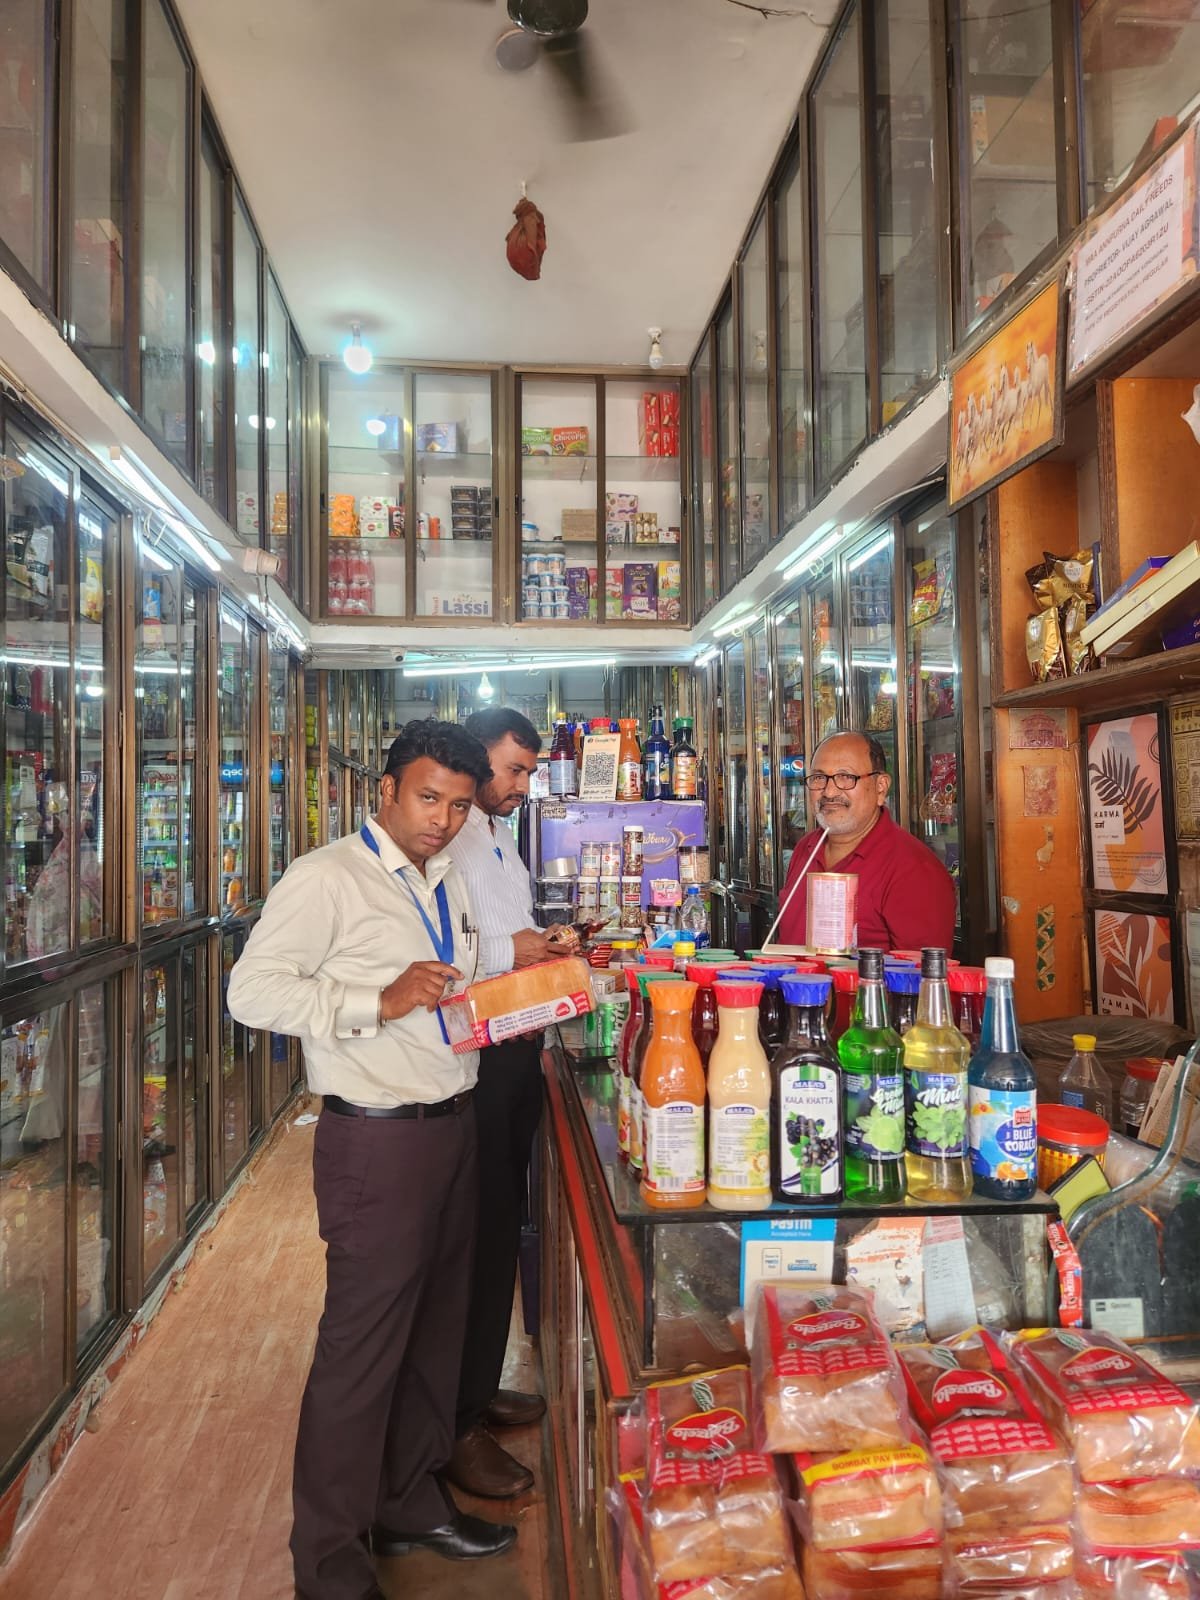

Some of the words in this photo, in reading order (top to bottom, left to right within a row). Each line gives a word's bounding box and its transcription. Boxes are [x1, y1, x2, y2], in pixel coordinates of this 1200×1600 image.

[1140, 198, 1174, 234] AGRAWAL
[443, 600, 489, 615] Lassi
[1094, 810, 1120, 818] KARMA
[1101, 997, 1130, 1012] YAMA
[785, 1095, 804, 1105] KALA
[806, 1096, 834, 1105] KHATTA
[917, 1084, 962, 1107] Mint
[1013, 1128, 1034, 1140] BLUE
[832, 1456, 871, 1471] BOMBAY
